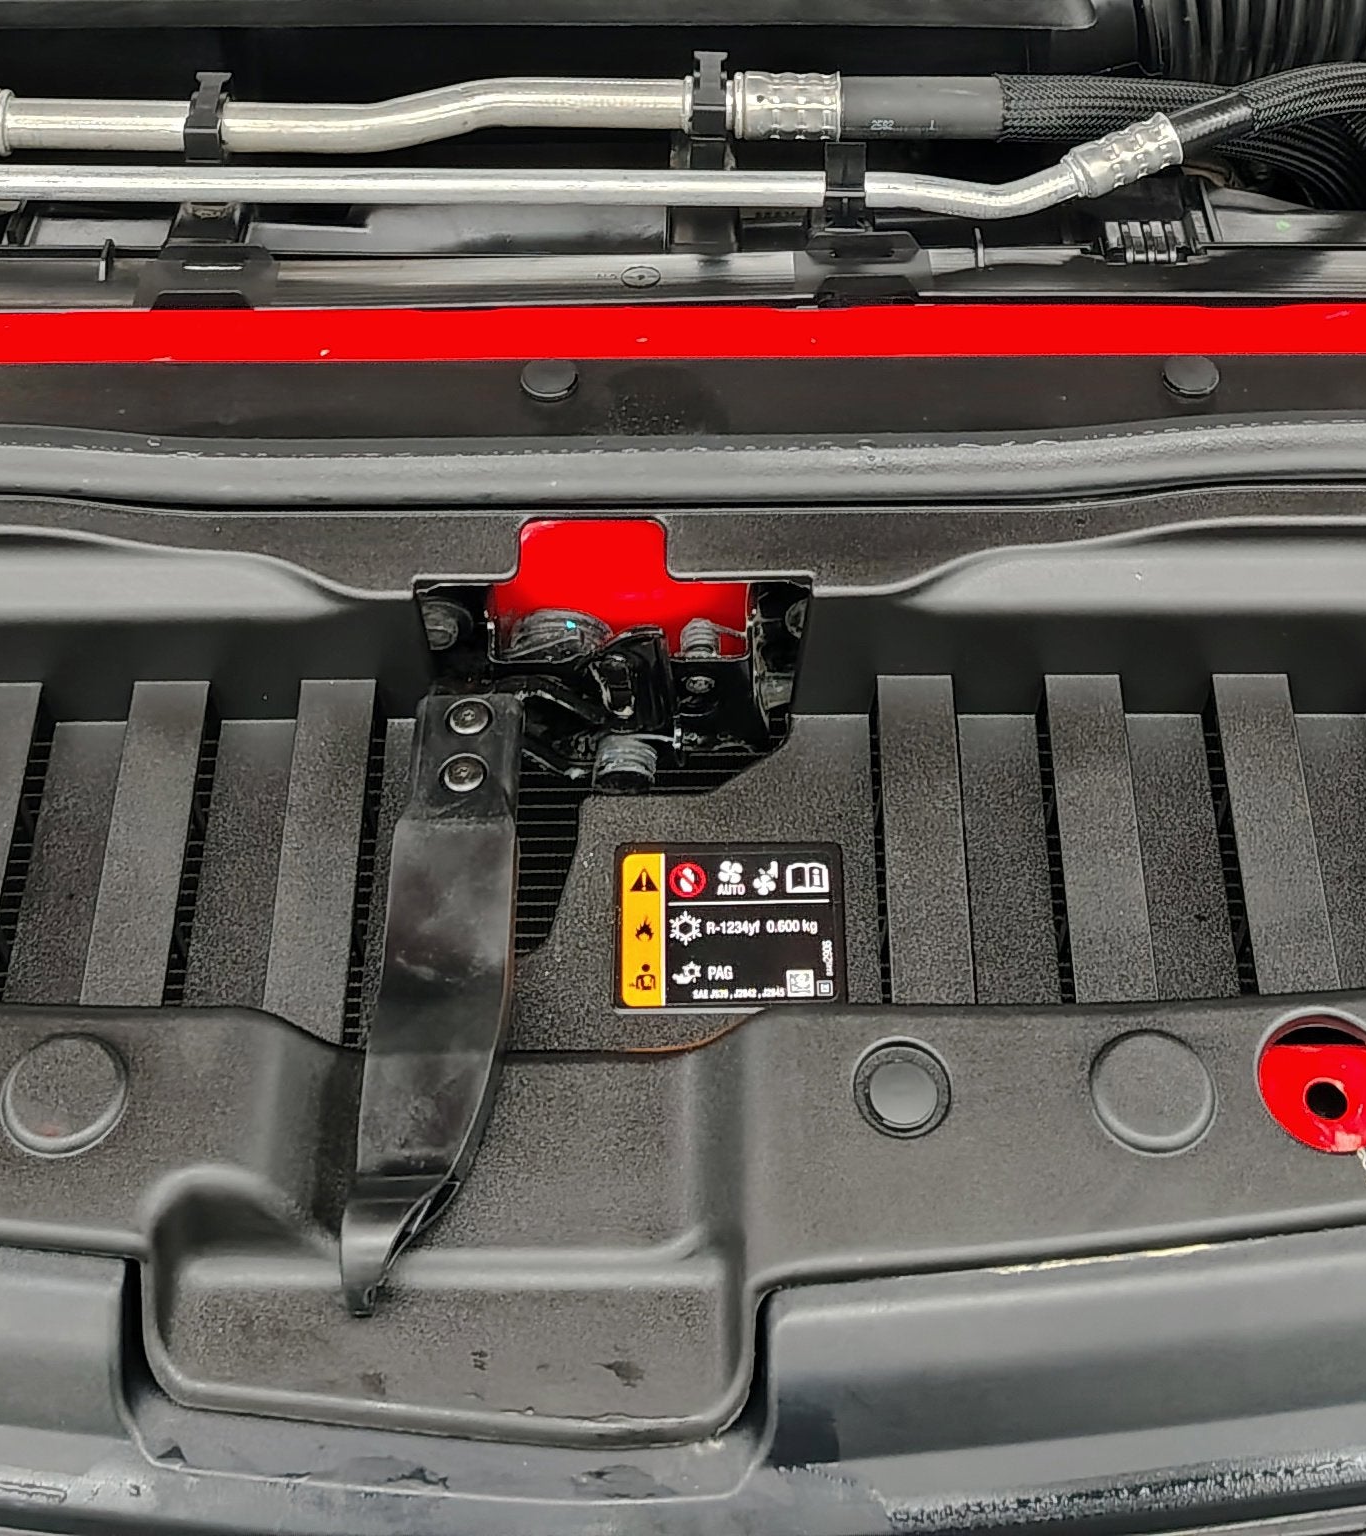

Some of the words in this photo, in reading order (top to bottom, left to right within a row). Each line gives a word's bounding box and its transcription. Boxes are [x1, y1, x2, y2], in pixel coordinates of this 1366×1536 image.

[717, 884, 746, 896] AUTO
[706, 920, 761, 936] R-1234yf
[766, 920, 800, 933] 0.600
[802, 918, 818, 935] kg
[707, 966, 734, 981] PAG
[692, 989, 709, 999] SAE
